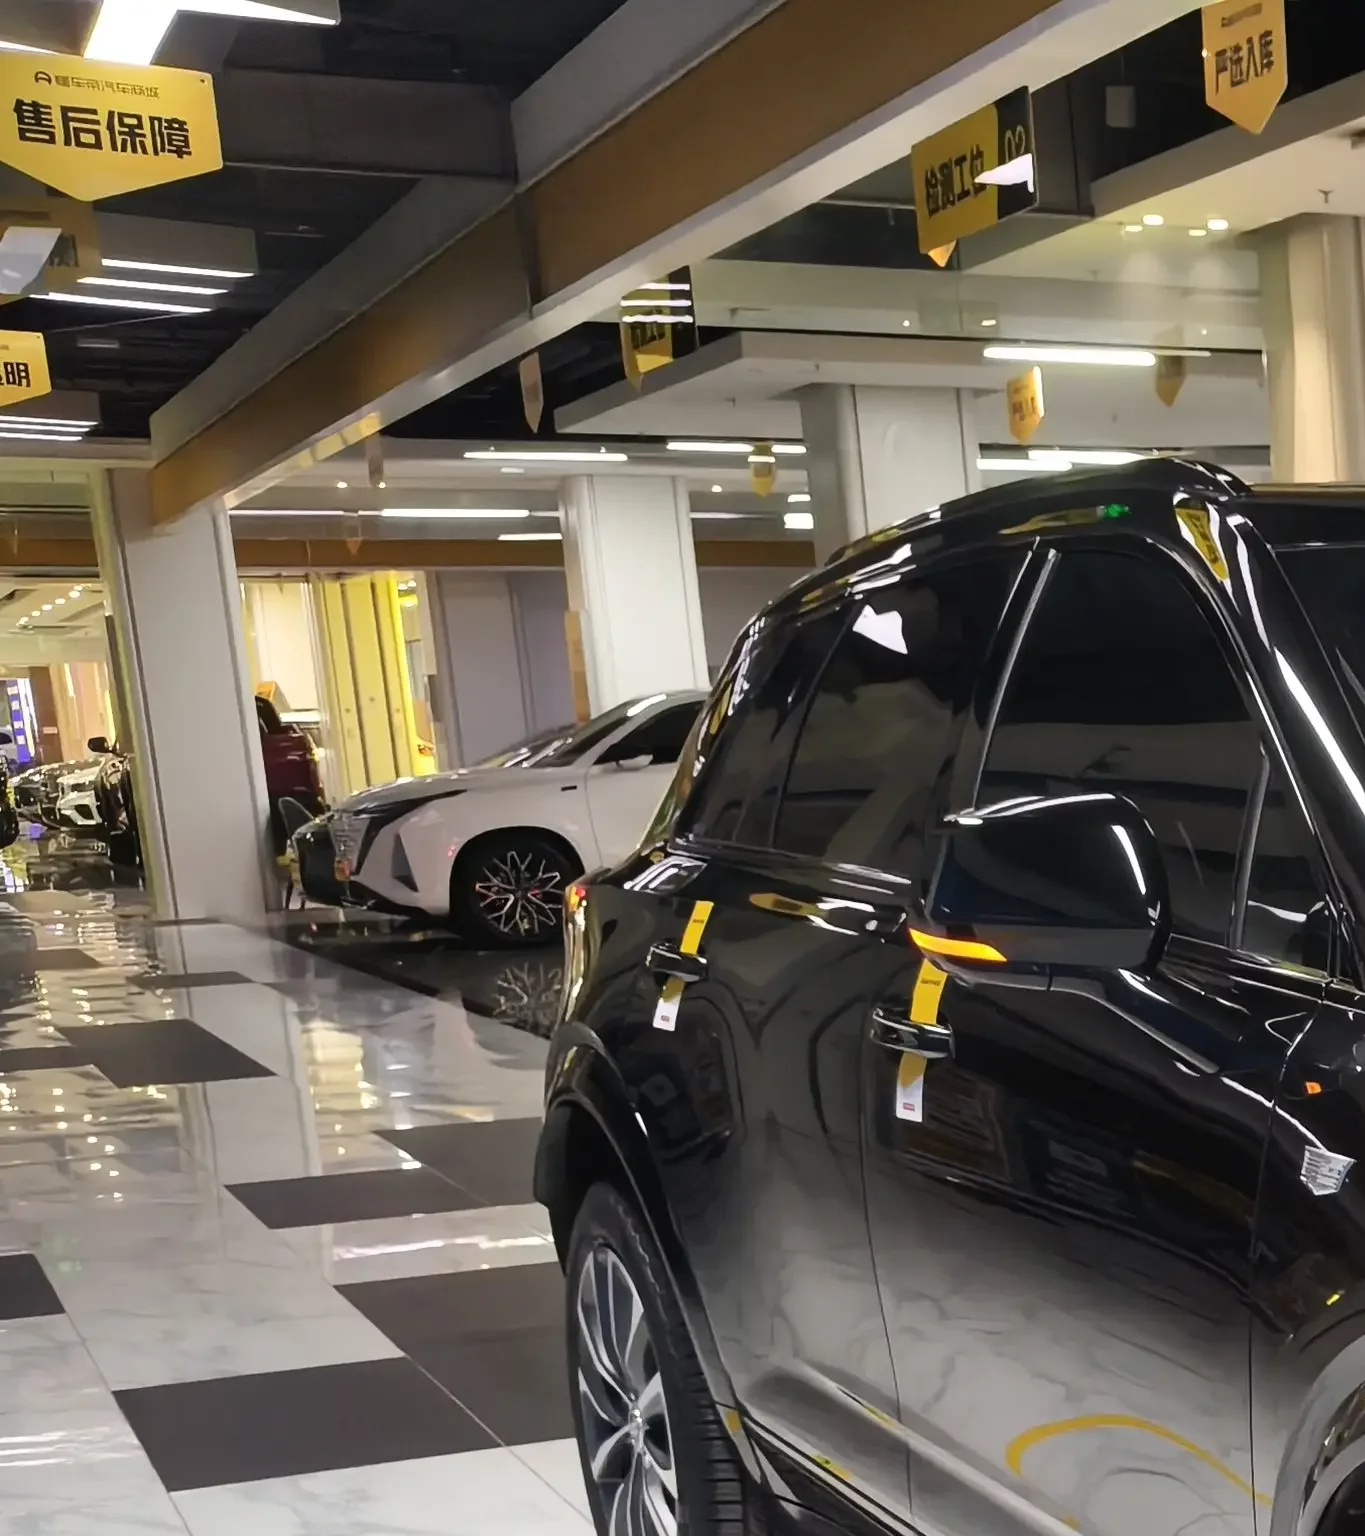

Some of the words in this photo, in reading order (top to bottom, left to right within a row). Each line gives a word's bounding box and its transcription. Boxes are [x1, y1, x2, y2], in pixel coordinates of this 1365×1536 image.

[1214, 29, 1275, 96] 严选入库
[13, 98, 192, 159] 售后保障
[924, 142, 988, 219] 检测工位
[0, 361, 31, 388] 明
